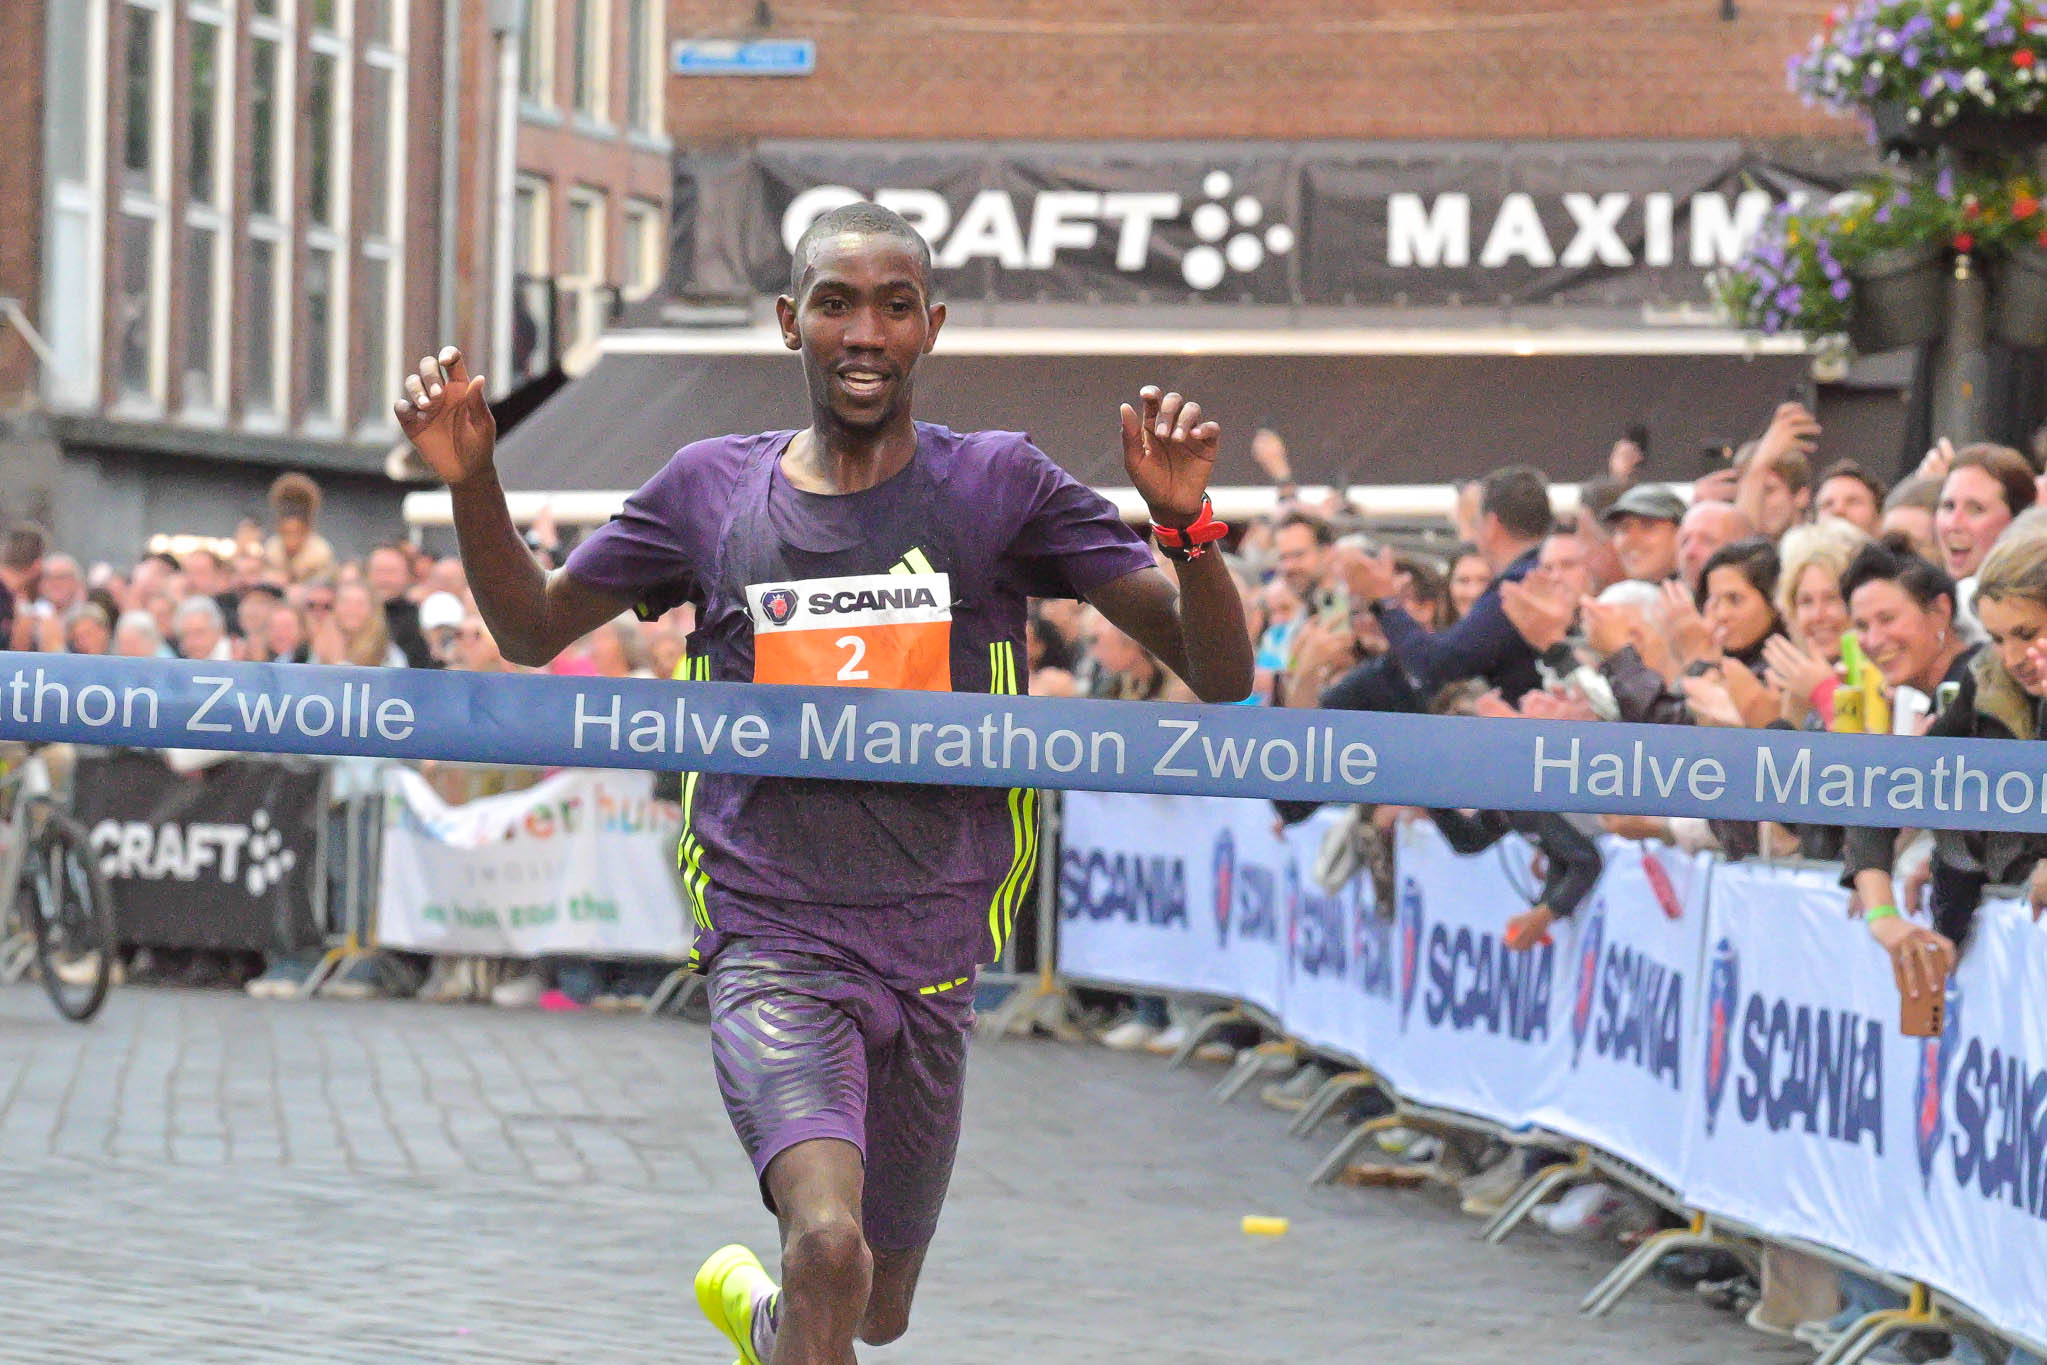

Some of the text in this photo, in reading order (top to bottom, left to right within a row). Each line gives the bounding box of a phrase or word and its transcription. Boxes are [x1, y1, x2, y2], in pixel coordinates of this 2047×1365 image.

[808, 587, 938, 615] SCANIA
[834, 635, 869, 681] 2
[0, 668, 416, 742] thon Zwolle
[573, 692, 1379, 786] Halve Marathon Zwolle
[1532, 736, 2047, 815] Halve Maratho
[89, 818, 249, 884] CRAFT
[1425, 922, 1555, 1043] SCANIA
[1736, 992, 1884, 1157] SCANIA
